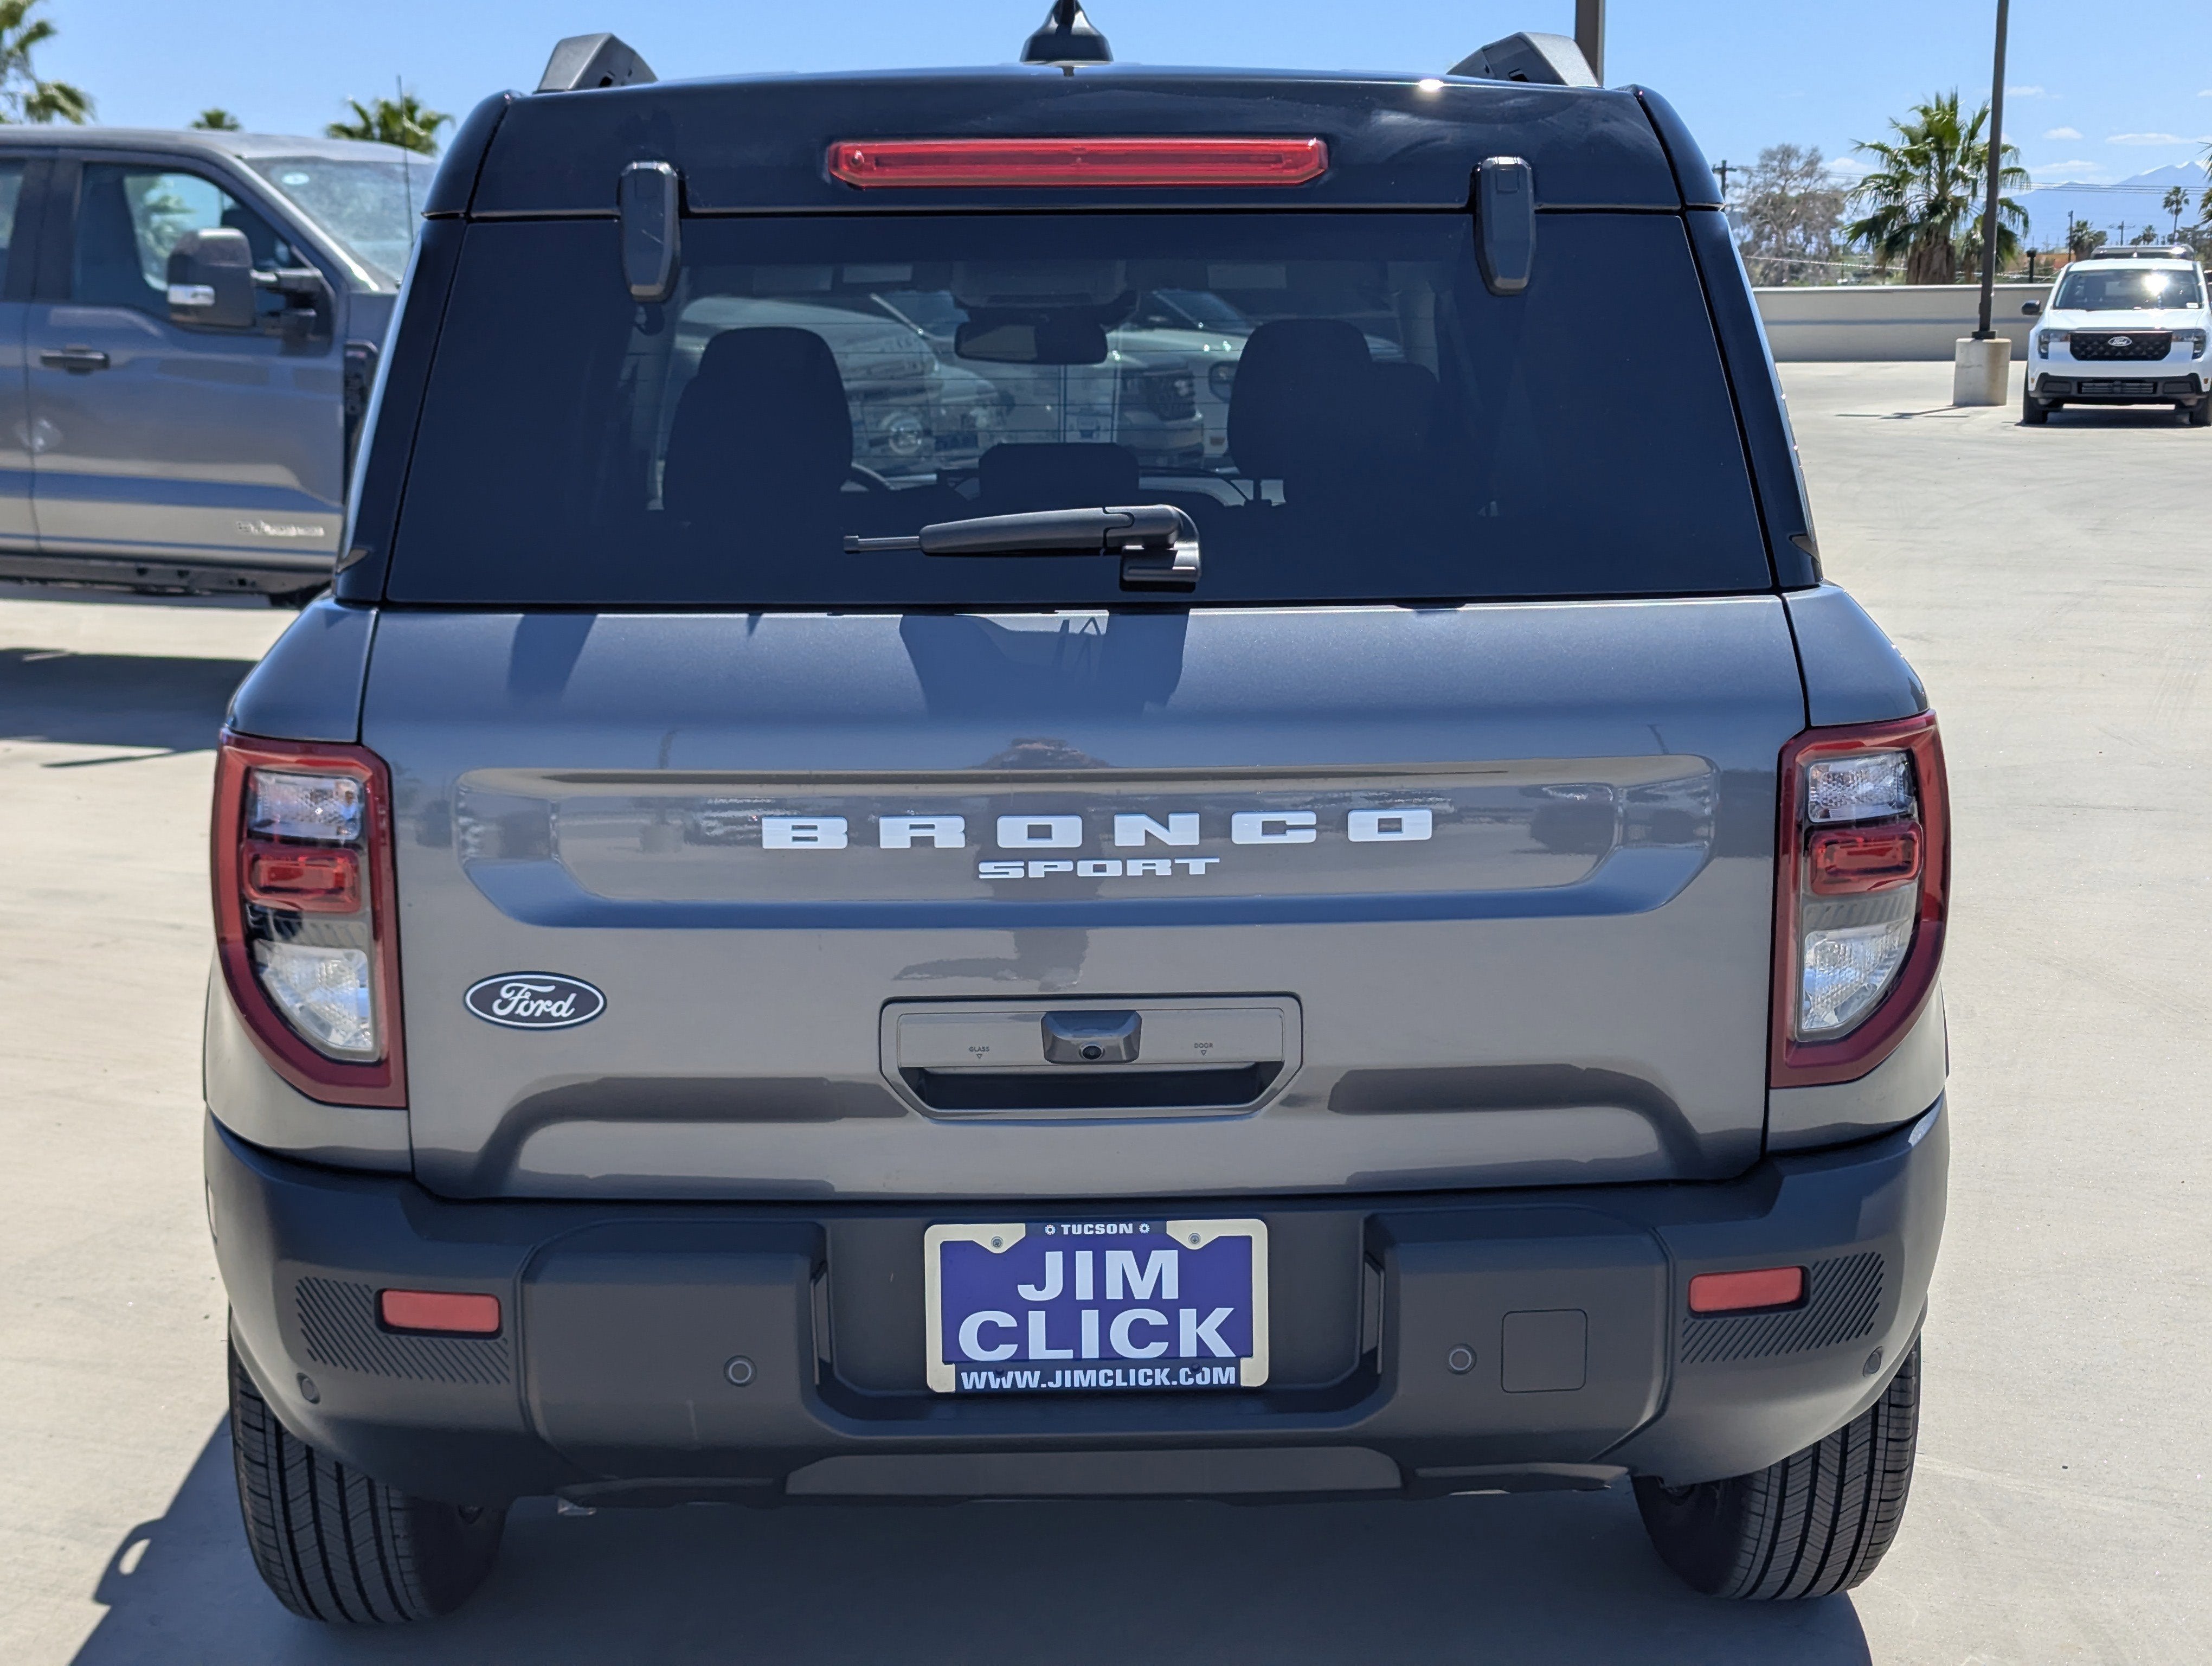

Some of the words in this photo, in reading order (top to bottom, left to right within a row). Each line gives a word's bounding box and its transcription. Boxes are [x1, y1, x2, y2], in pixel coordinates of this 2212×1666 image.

[762, 810, 1432, 849] BRONCO
[979, 857, 1220, 879] SPORT
[492, 983, 577, 1017] Ford
[1061, 1223, 1133, 1235] TUCSON
[1018, 1250, 1179, 1302] JIM
[959, 1308, 1236, 1361] CLICK
[961, 1367, 1236, 1390] WWW.JIMCLICK.COM
